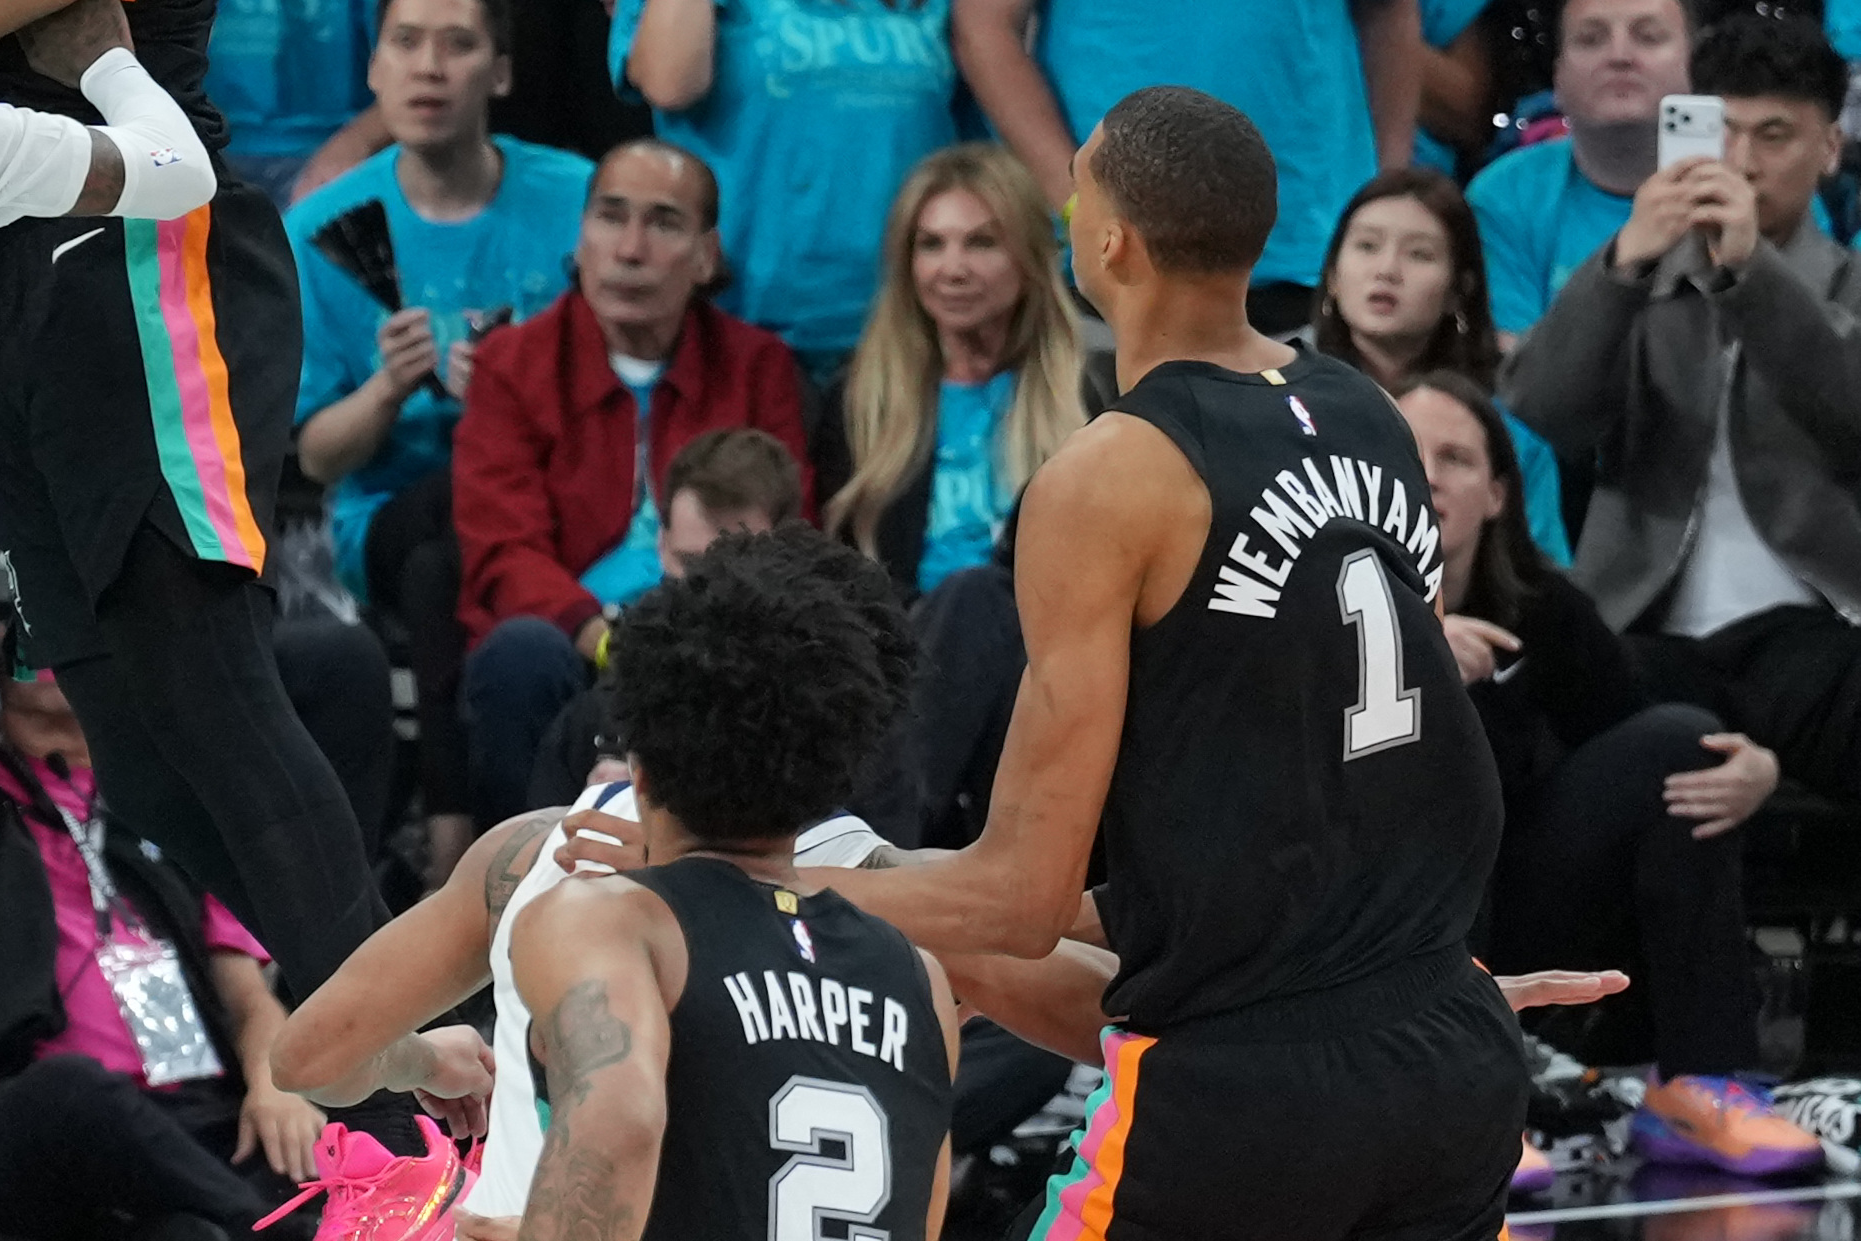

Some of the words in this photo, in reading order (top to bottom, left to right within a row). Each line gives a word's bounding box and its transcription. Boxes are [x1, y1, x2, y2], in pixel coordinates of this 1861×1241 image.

[1207, 454, 1445, 620] WEMBANYAMA
[1335, 546, 1422, 763] 1
[723, 969, 908, 1073] HARPER
[767, 1074, 892, 1241] 2
